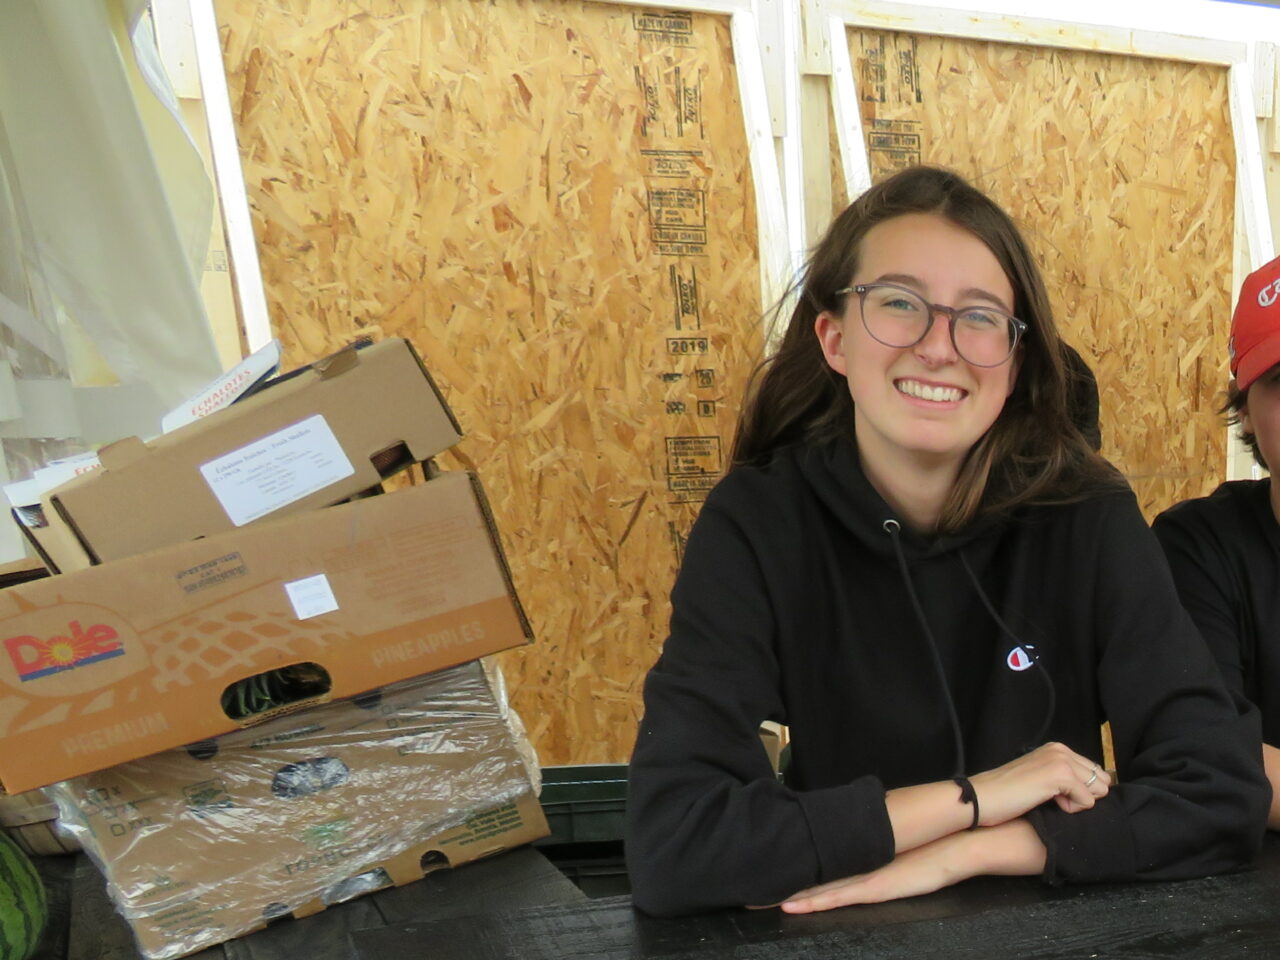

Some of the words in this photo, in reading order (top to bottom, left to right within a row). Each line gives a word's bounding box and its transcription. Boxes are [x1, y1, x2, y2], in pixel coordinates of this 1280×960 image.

[670, 340, 706, 353] 2019
[4, 620, 120, 676] Dole
[372, 621, 486, 668] PINEAPPLES
[62, 712, 169, 757] PREMIUM
